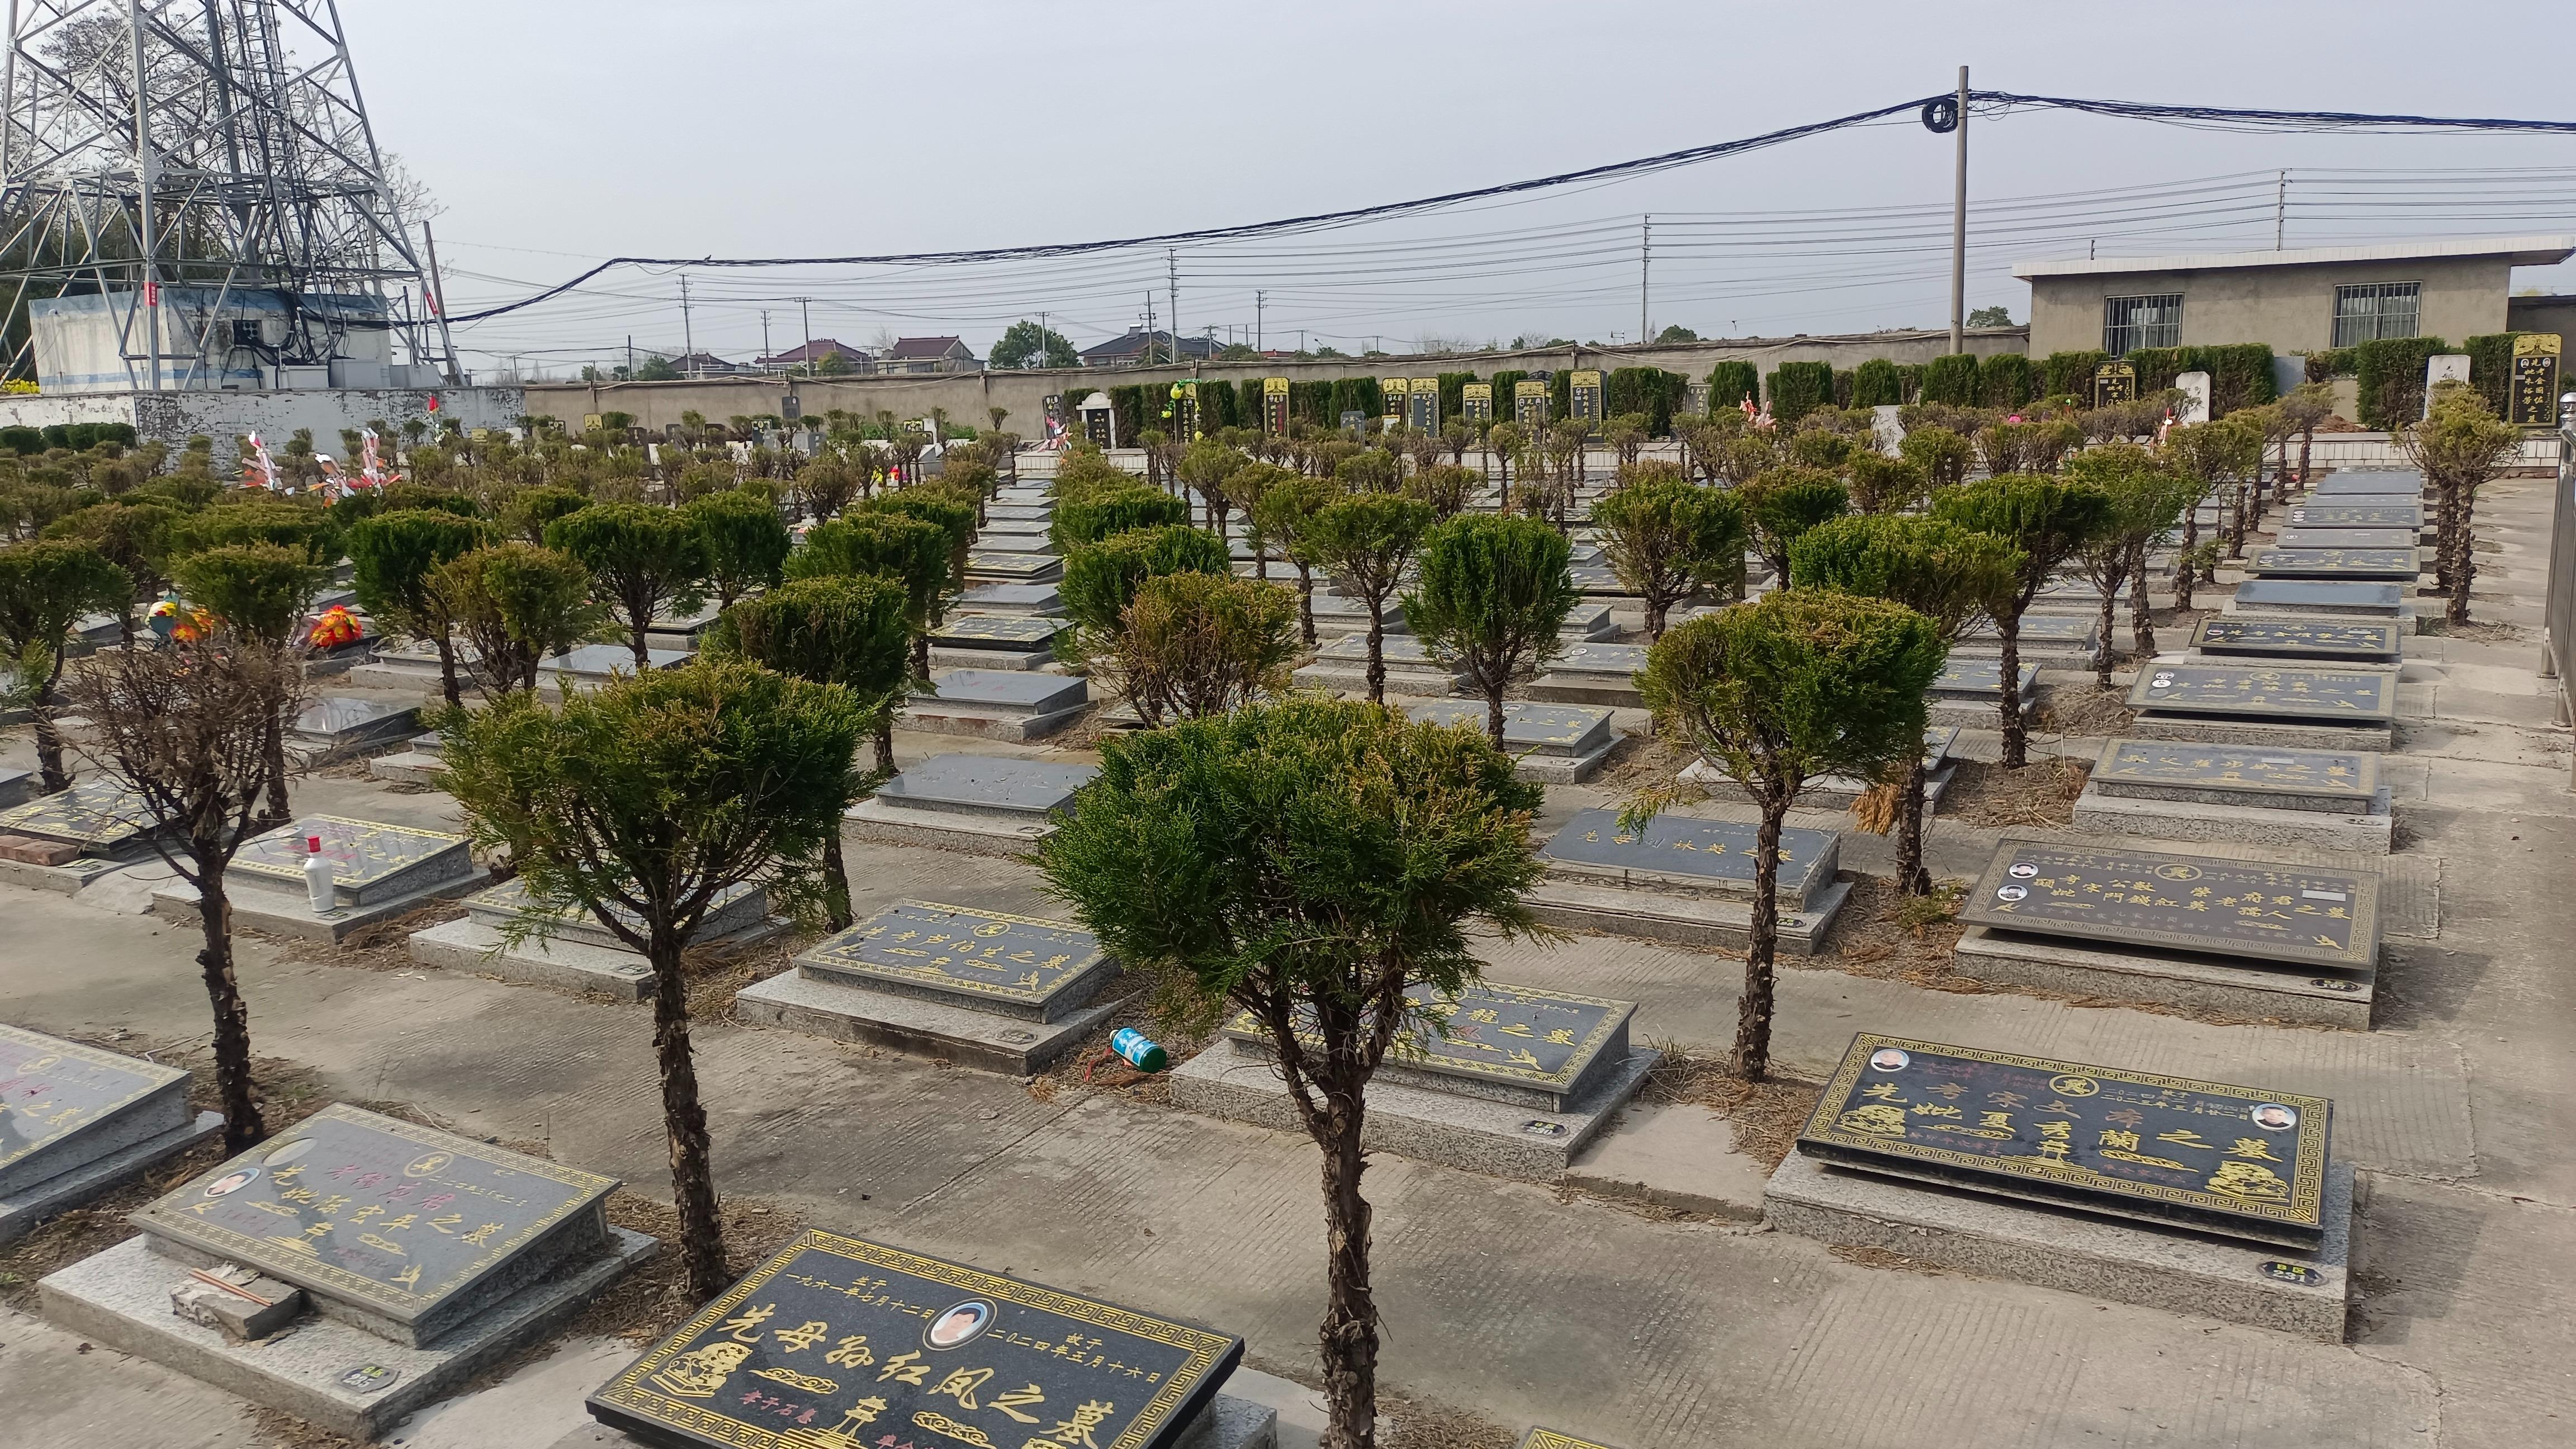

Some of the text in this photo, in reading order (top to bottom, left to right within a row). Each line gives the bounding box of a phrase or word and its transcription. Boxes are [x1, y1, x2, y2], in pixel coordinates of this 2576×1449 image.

[851, 1275, 887, 1291] 生于
[2272, 1270, 2305, 1282] 231
[1063, 1332, 1102, 1349] 故于
[343, 1374, 376, 1388] 235
